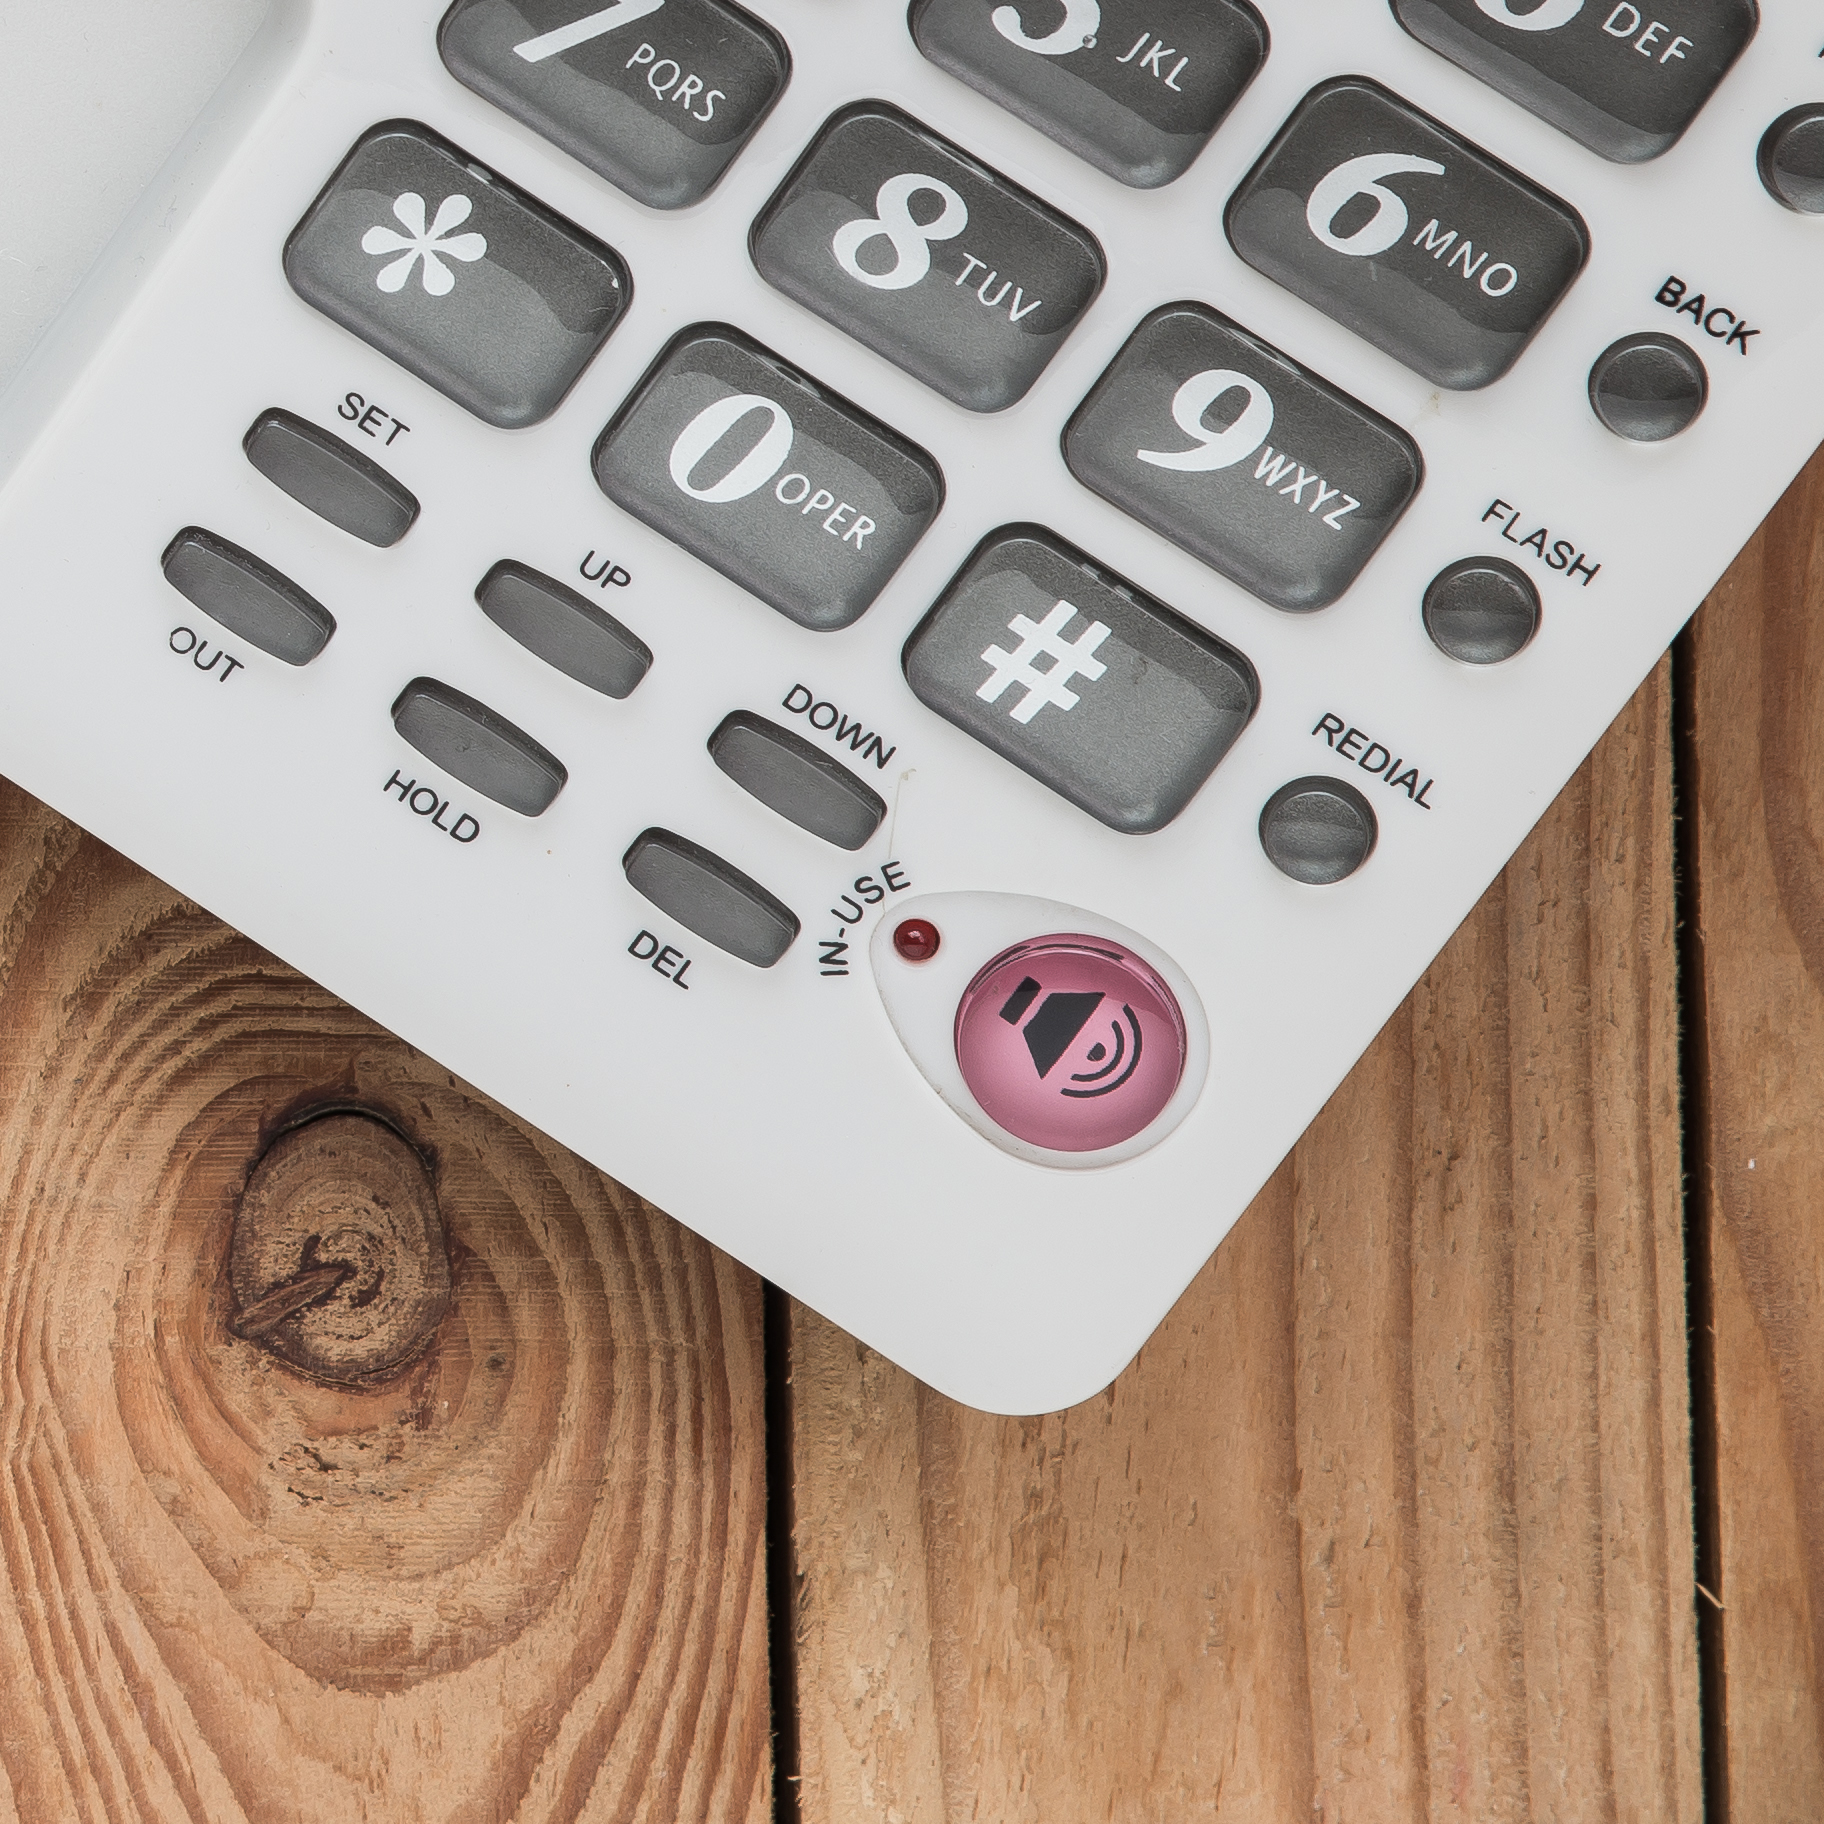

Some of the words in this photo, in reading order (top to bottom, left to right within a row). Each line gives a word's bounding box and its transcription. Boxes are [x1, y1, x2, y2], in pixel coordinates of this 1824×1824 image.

[1116, 32, 1189, 92] JKL
[1602, 1, 1693, 64] DEF
[625, 43, 726, 122] PQRS
[831, 173, 968, 291] 8
[958, 251, 1042, 323] TUV
[1305, 152, 1445, 257] 6
[1413, 218, 1518, 297] MNO
[1654, 275, 1761, 356] BACK
[337, 391, 411, 446] SET
[1135, 368, 1274, 473] 9
[1253, 446, 1361, 531] WXYZ
[668, 393, 794, 504] 0
[774, 472, 877, 551] OPER
[579, 550, 632, 589] UP
[1481, 498, 1602, 587] FLASH
[169, 626, 245, 683] OUT
[976, 598, 1111, 725] #
[781, 683, 897, 770] DOWN
[1311, 712, 1434, 810] REDIAL
[383, 769, 481, 844] HOLD
[627, 929, 692, 990] DEL
[818, 860, 911, 977] IN-USE
